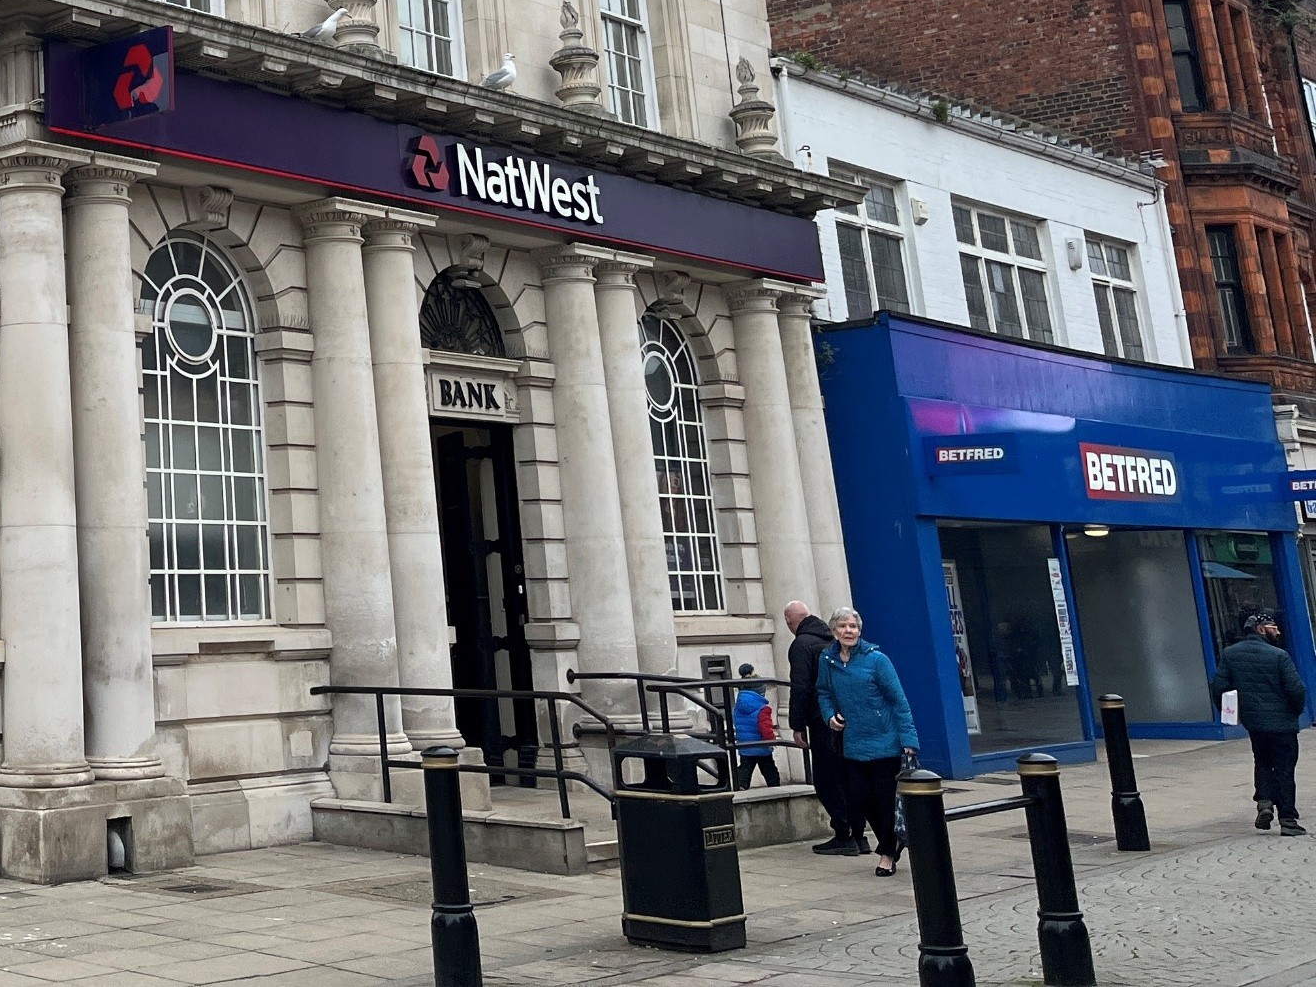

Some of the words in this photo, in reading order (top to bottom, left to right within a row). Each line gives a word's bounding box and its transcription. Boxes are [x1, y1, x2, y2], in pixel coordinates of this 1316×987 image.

[456, 142, 604, 224] NatWest
[439, 379, 501, 409] BANK
[939, 448, 1004, 461] BETFRED
[1086, 451, 1177, 496] BETFRED
[705, 830, 733, 845] LITTER
